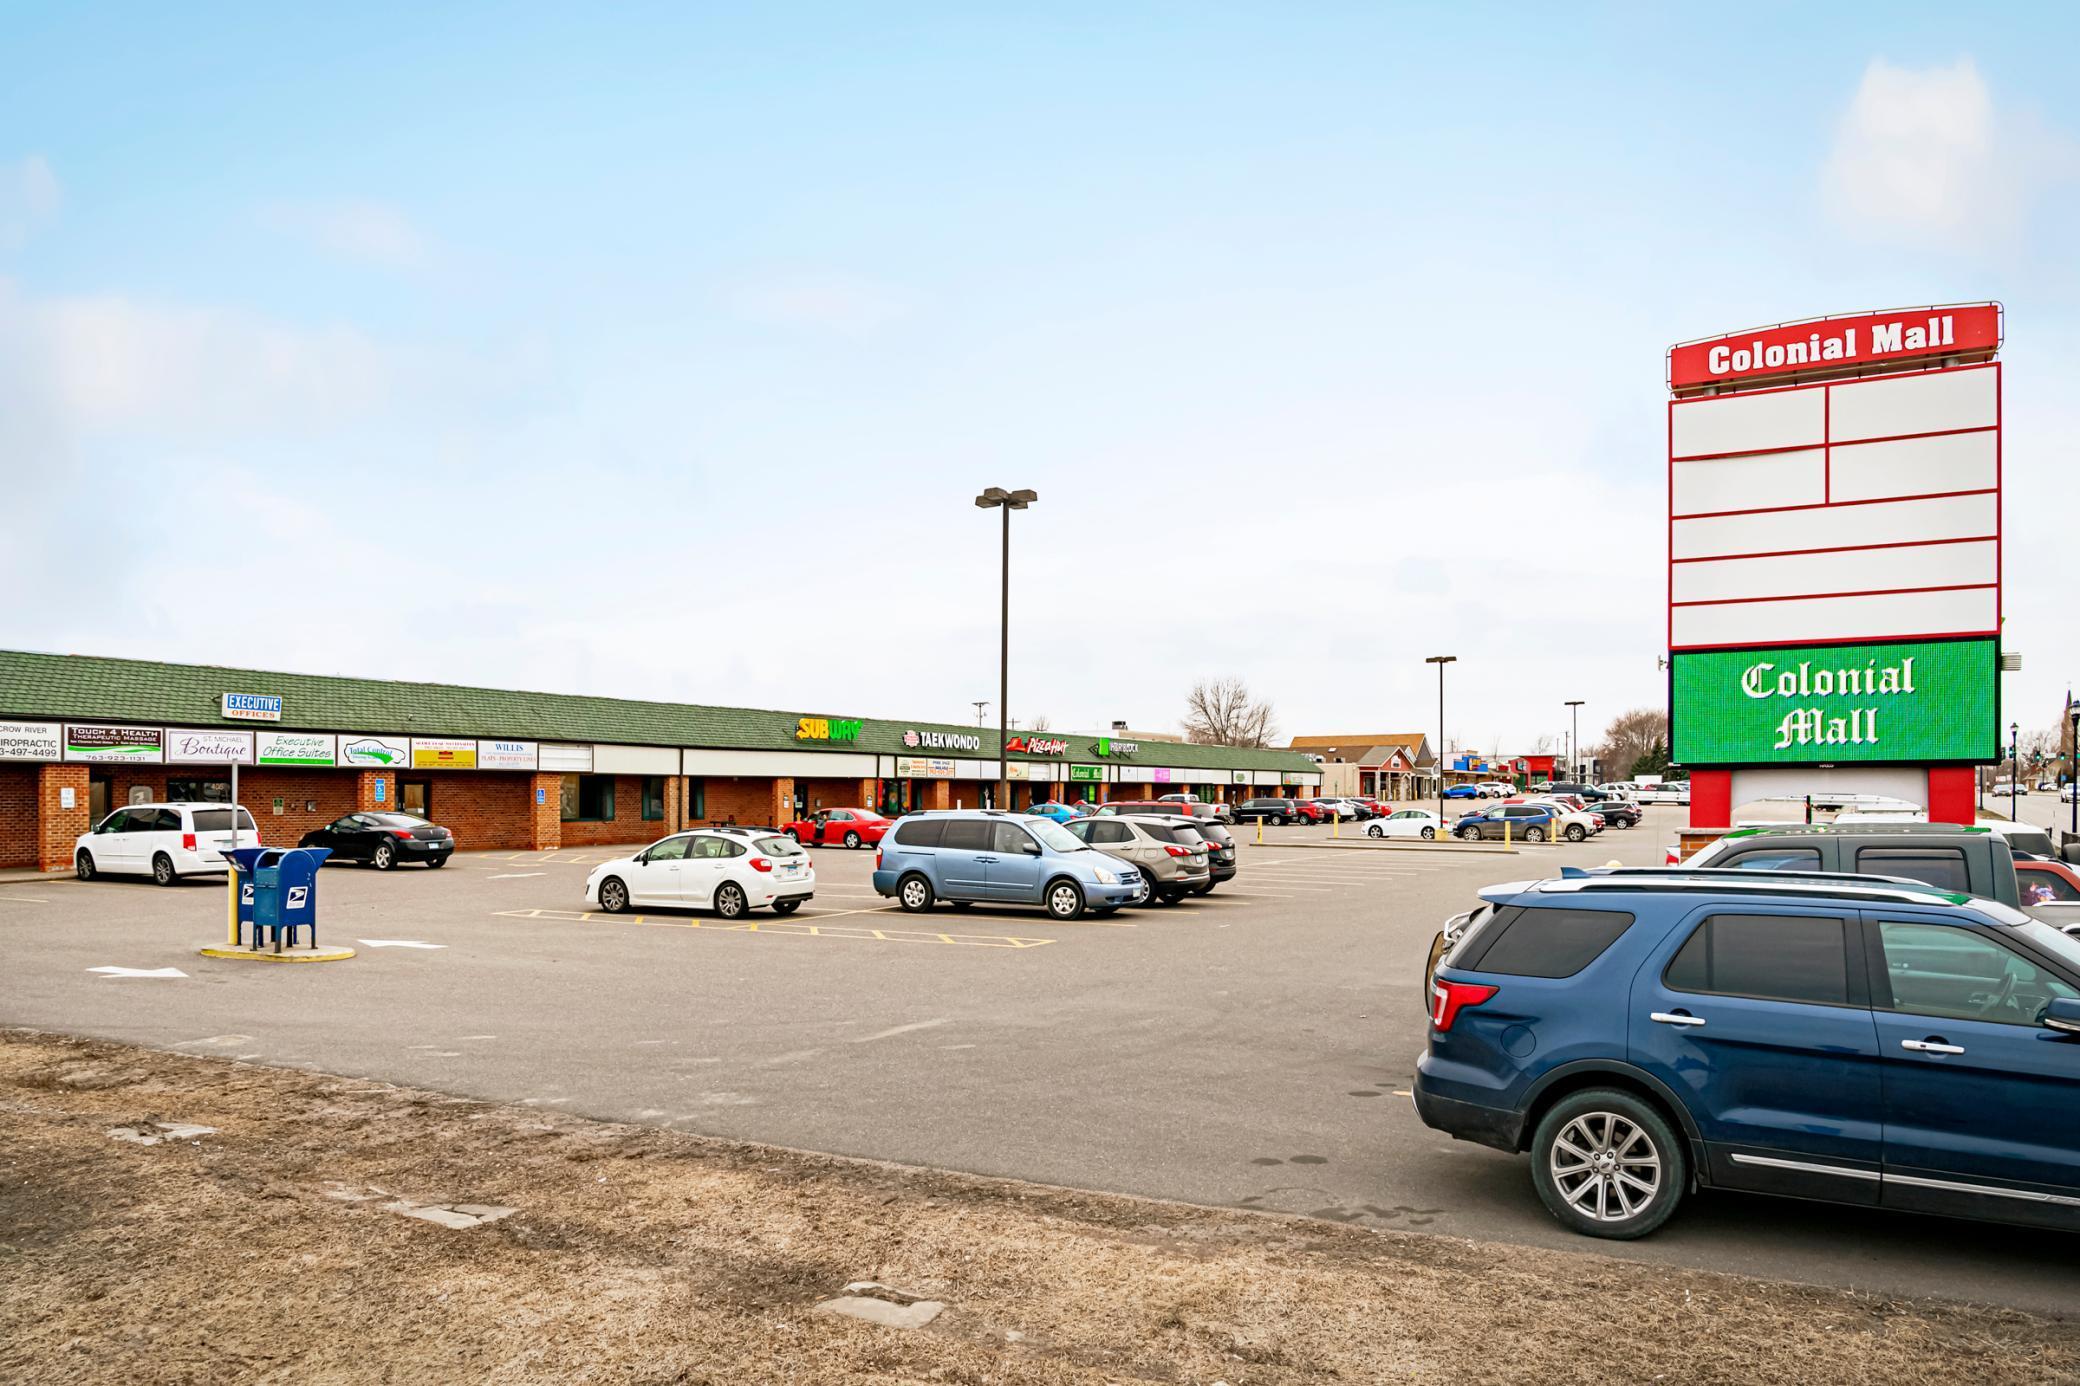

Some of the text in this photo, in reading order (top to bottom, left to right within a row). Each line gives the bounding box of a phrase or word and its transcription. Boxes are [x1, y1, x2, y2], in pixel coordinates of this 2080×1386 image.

[1708, 315, 1954, 375] Colonial Mall
[1741, 657, 1915, 699] Colonial
[229, 695, 279, 711] EXECUTIVE
[231, 710, 275, 719] OFFICES
[72, 727, 106, 735] TOUCH
[121, 729, 158, 737] HEALTH
[796, 718, 864, 741] SUBWAY
[1774, 707, 1880, 750] Mall
[180, 737, 246, 759] Boutique
[275, 736, 324, 746] Executive
[495, 743, 524, 751] WILLIS
[920, 731, 980, 750] TAEKWONDO
[1027, 737, 1069, 756] Pizza Hut
[263, 746, 332, 758] Office Suites
